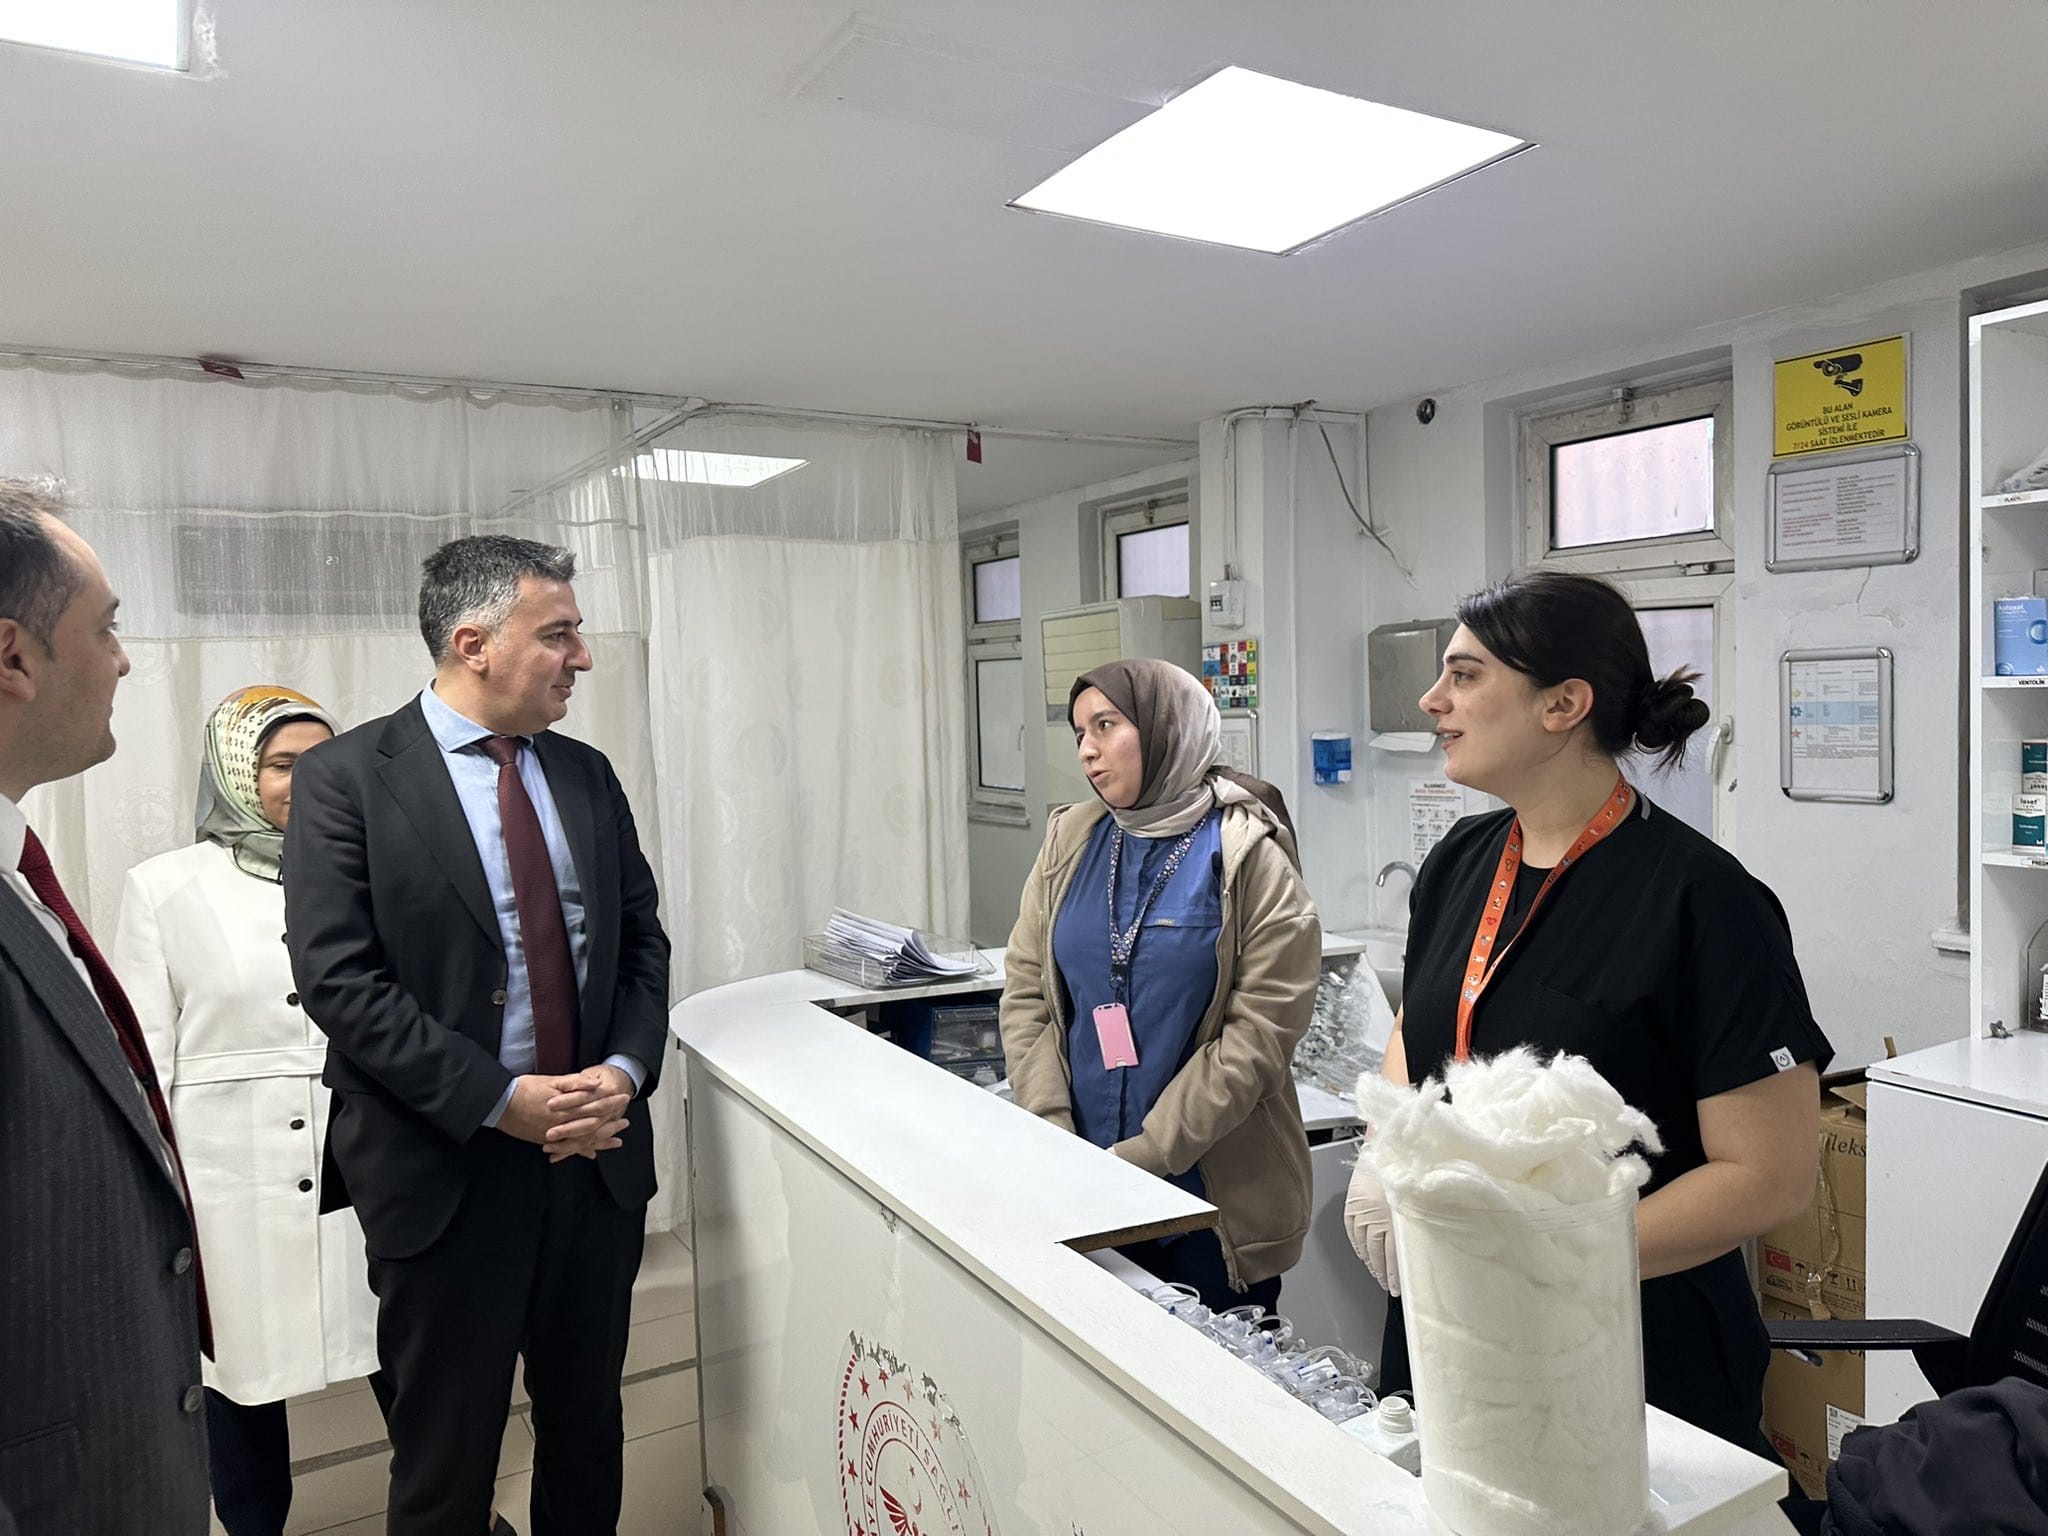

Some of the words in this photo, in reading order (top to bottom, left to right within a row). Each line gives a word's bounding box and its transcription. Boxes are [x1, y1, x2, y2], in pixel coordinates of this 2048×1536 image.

[1786, 416, 1830, 432] GÖRÜNTÜLÜ
[1831, 414, 1841, 425] VE
[1841, 411, 1861, 424] SESLİ
[1862, 406, 1893, 419] KAMERA
[1823, 406, 1833, 415] BU
[1834, 402, 1854, 413] ALAN
[1793, 441, 1809, 451] 7/24
[1810, 437, 1827, 449] SAAT
[1828, 427, 1886, 445] İZLENMEKTEDİR
[1818, 424, 1846, 437] SİSTEMİ
[1846, 422, 1858, 433] İLE
[865, 1408, 920, 1487] CUMHURİYETİ
